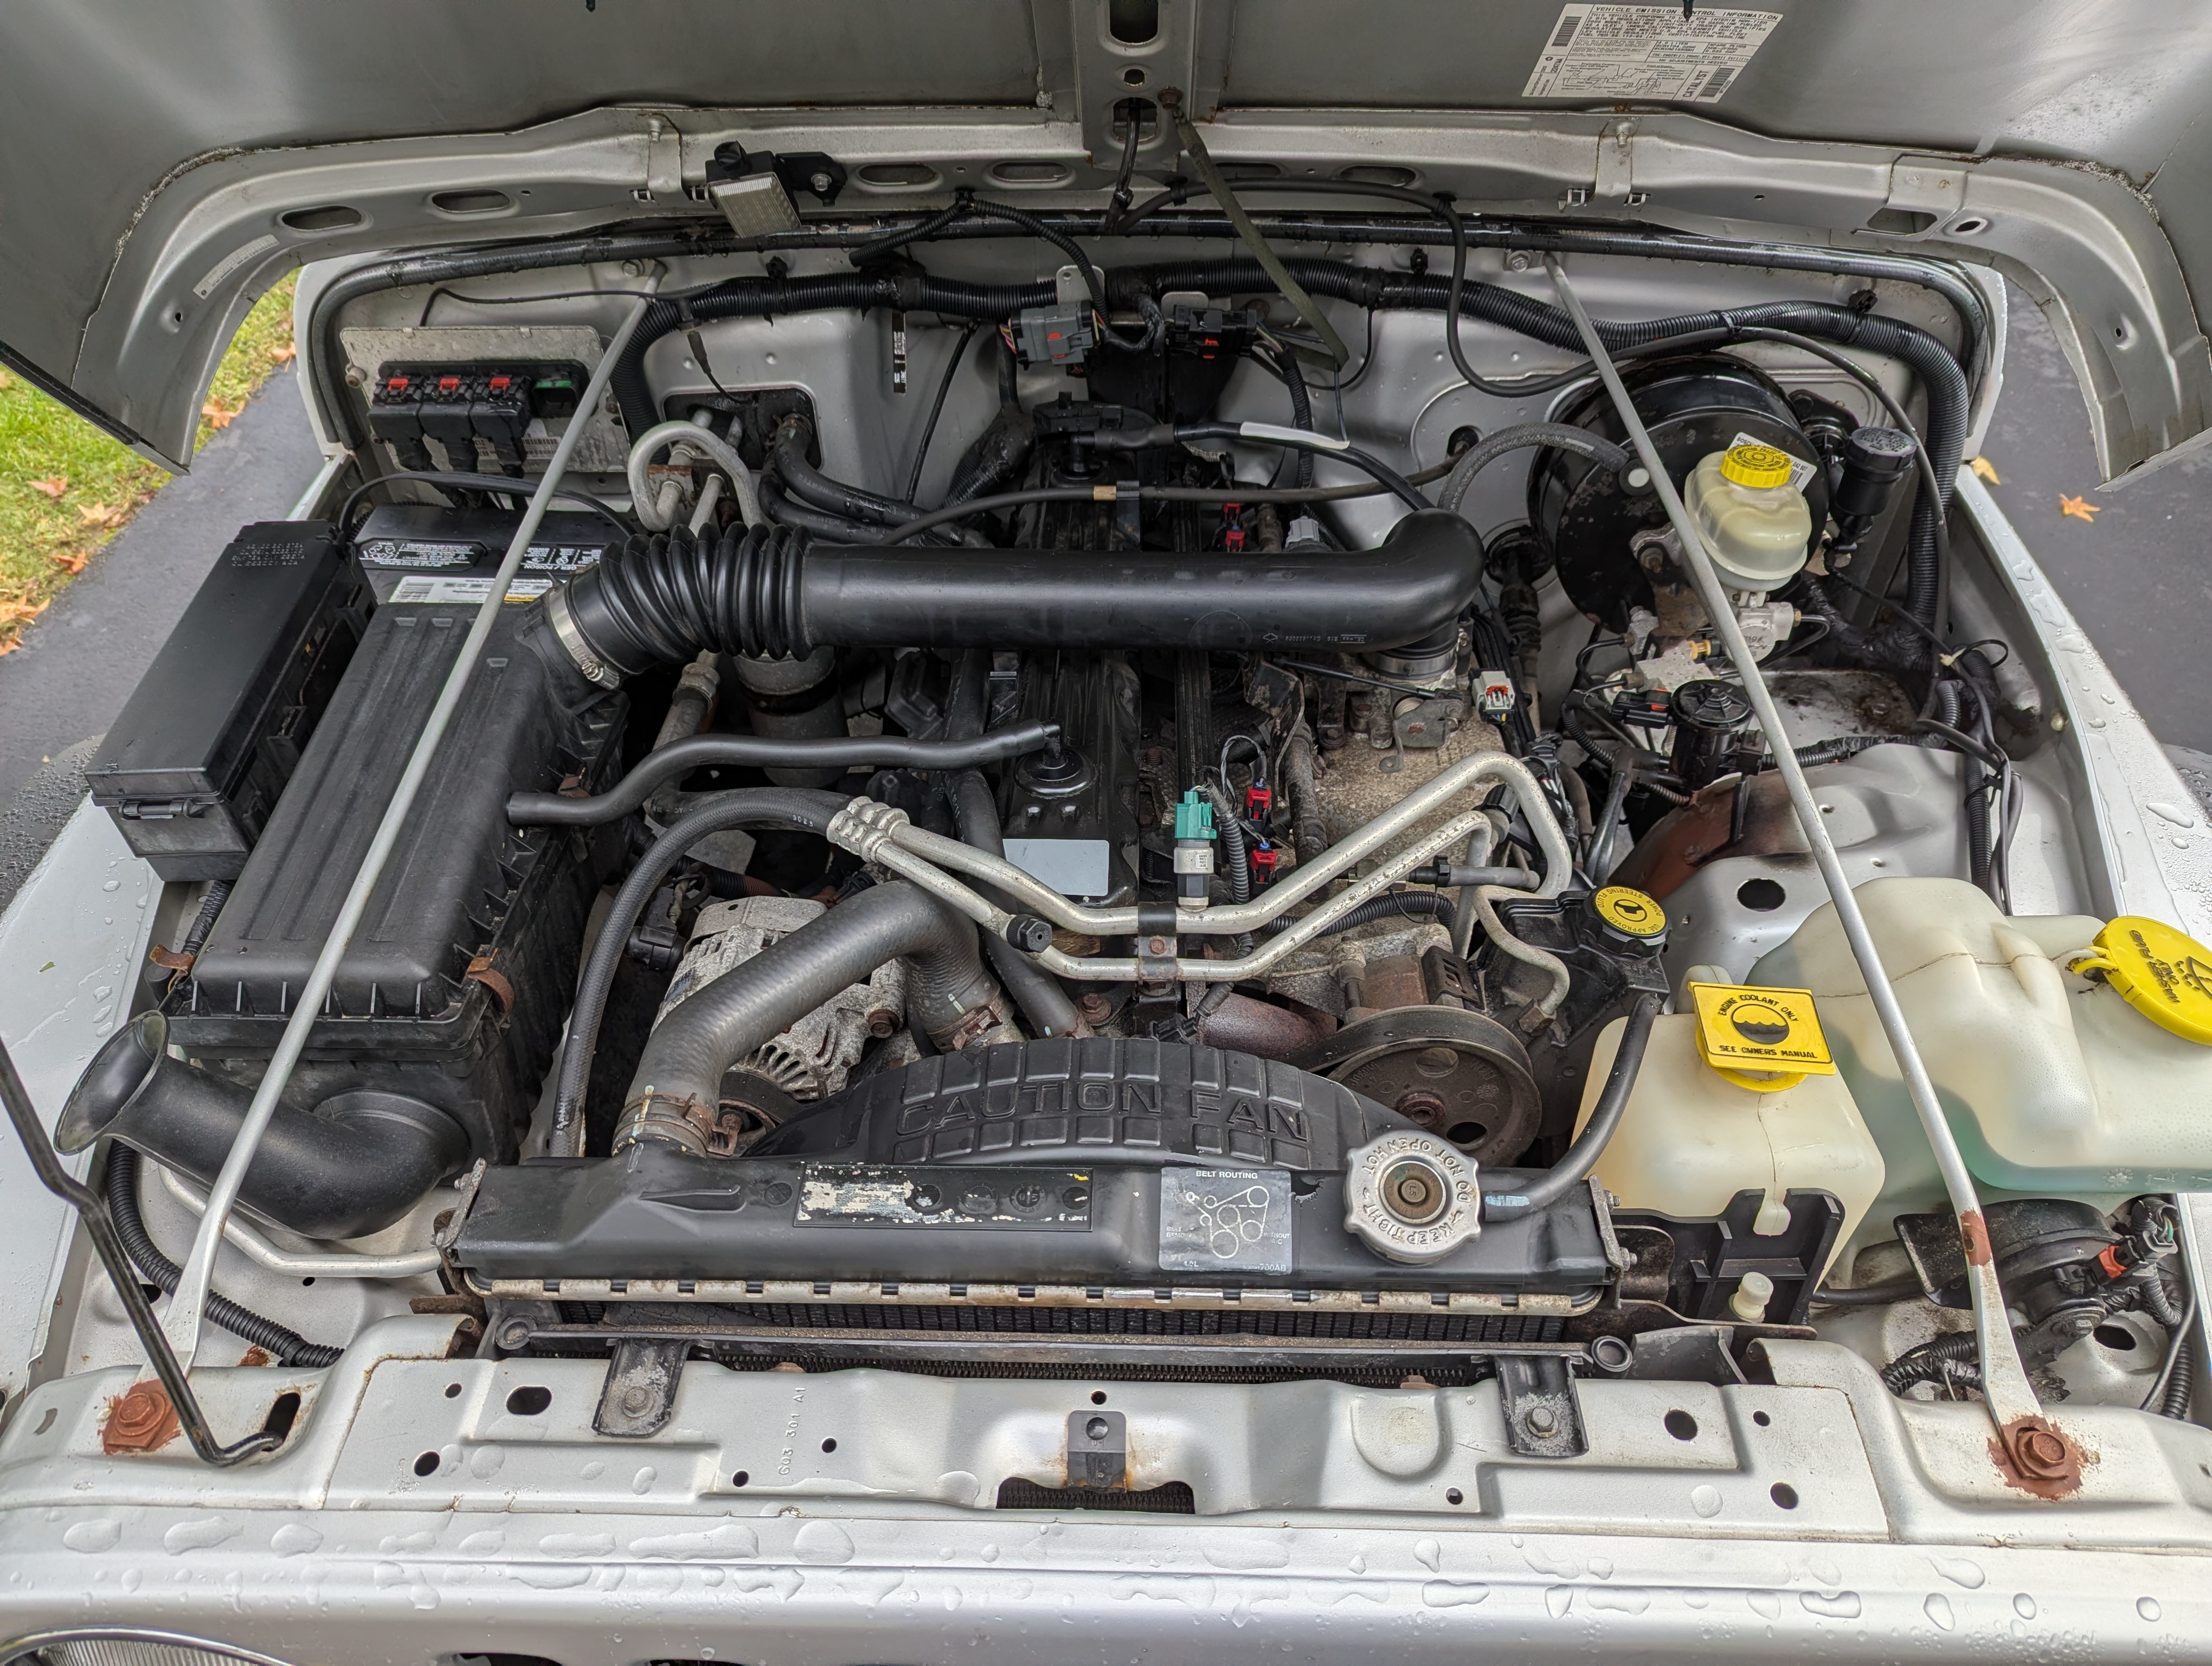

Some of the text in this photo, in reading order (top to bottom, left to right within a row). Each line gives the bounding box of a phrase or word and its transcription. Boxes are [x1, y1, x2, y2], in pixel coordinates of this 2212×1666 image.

[1681, 70, 1710, 97] CATALYST
[792, 814, 813, 827] 3025
[1597, 887, 1663, 917] POWER STEERING FLUID
[1608, 915, 1661, 933] USE APPROVED
[2129, 930, 2181, 1003] WASHER FLUID
[2157, 958, 2180, 985] ONLY
[1718, 994, 1799, 1023] ENGINE COOLANT ONLY
[1719, 1045, 1818, 1059] SEE OWNERS MANUAL
[896, 1081, 1309, 1143] CAUTION FAN
[1219, 1171, 1258, 1180] ROUTING
[1362, 1137, 1472, 1203] DO NOT OPEN HOT
[1362, 1203, 1454, 1245] KEEP TIGHT
[785, 1413, 800, 1438] 301
